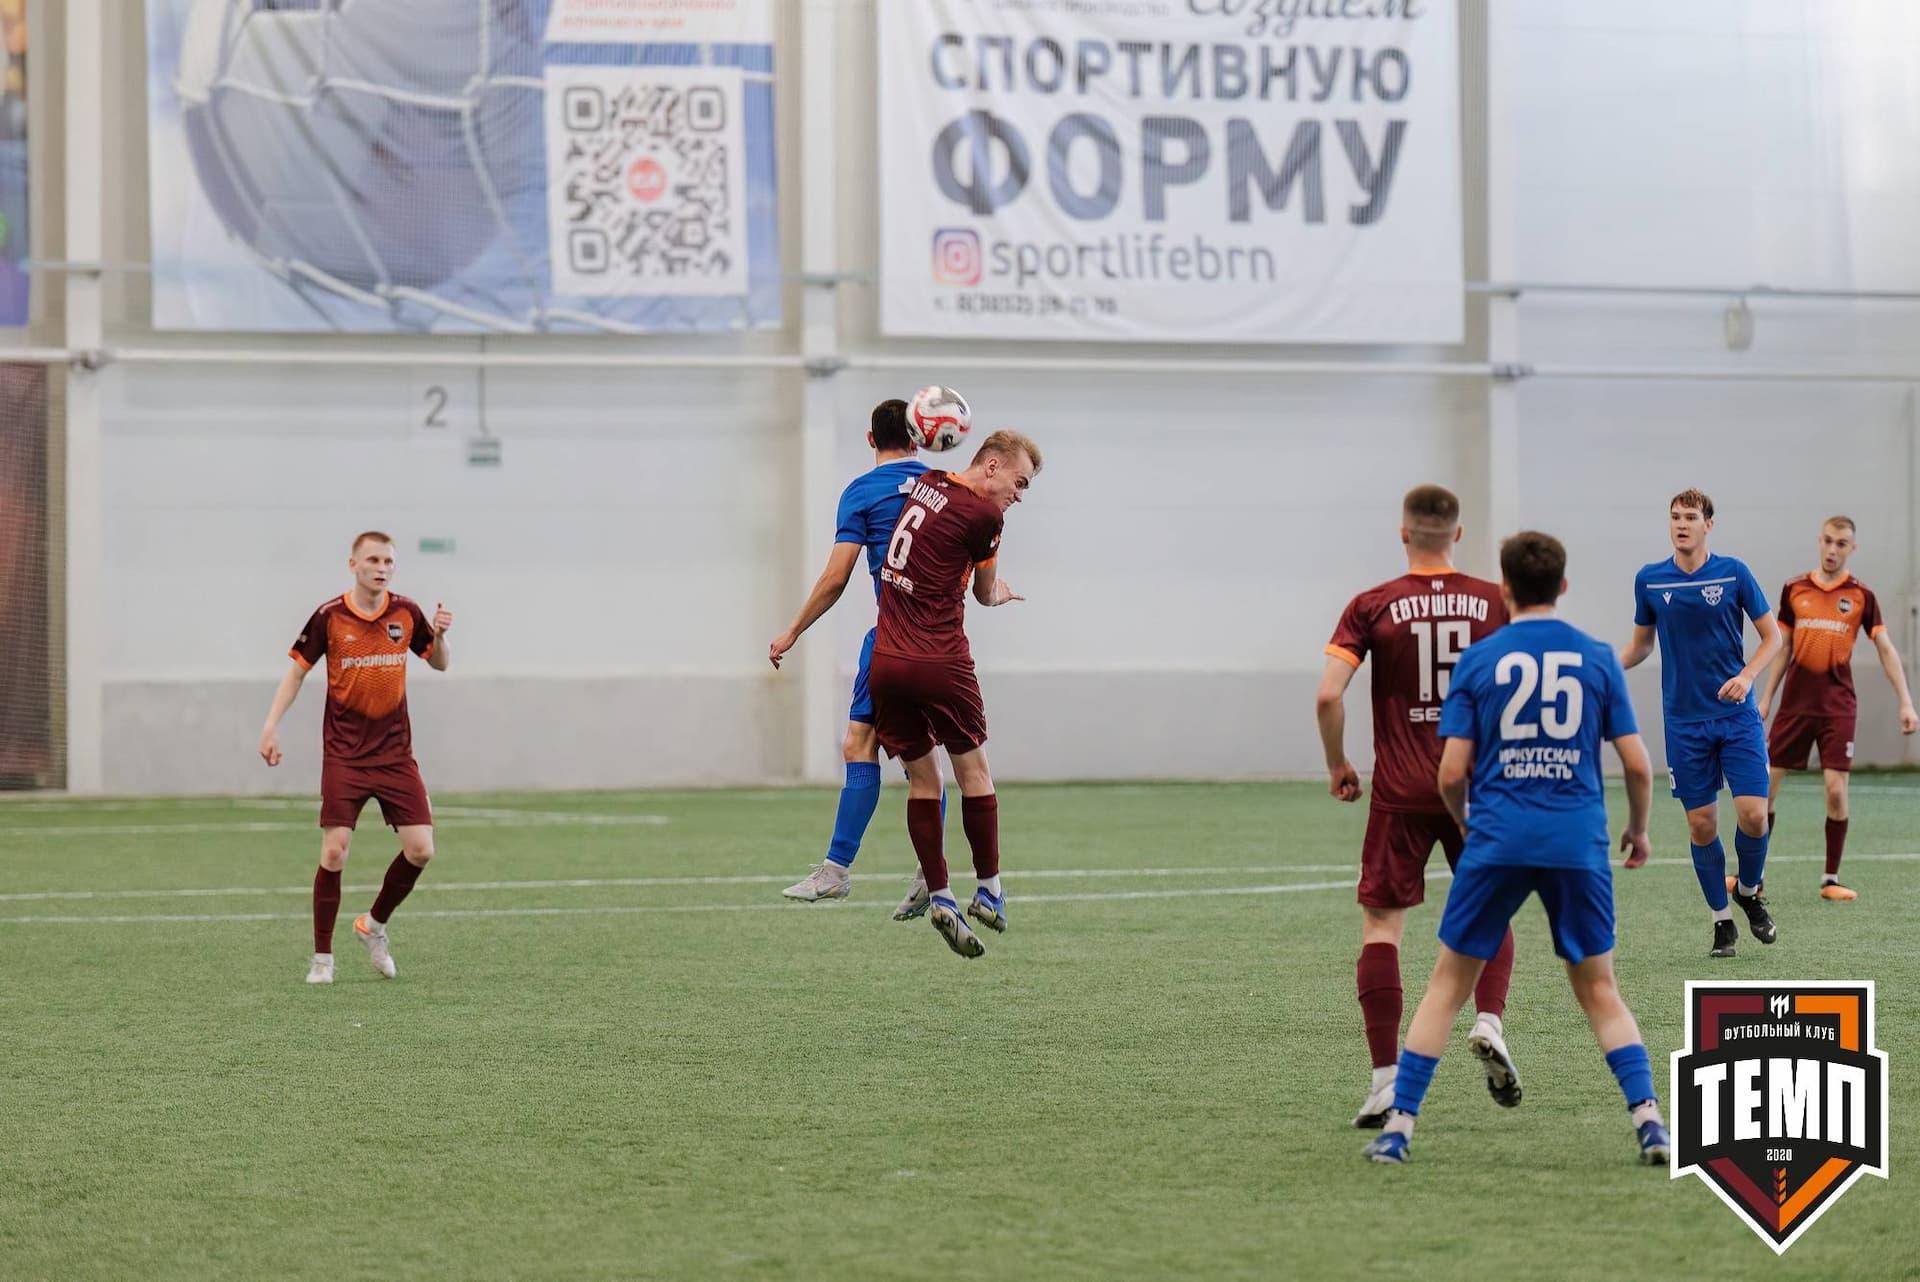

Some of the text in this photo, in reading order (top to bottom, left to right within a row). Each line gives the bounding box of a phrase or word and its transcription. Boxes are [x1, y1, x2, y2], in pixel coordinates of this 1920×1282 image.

[930, 33, 1412, 103] СПОРТИВНУЮ
[932, 107, 1409, 227] ФОРМУ
[992, 233, 1277, 287] sportlifebrn
[423, 384, 449, 428] 2
[887, 505, 926, 570] 6
[1389, 593, 1489, 624] ЕВТУШЕНКО
[1409, 707, 1442, 722] SE
[1495, 651, 1583, 741] 25
[1499, 747, 1581, 765] ИРКУТСКАЯ
[1504, 763, 1573, 779] ОБЛАСТЬ
